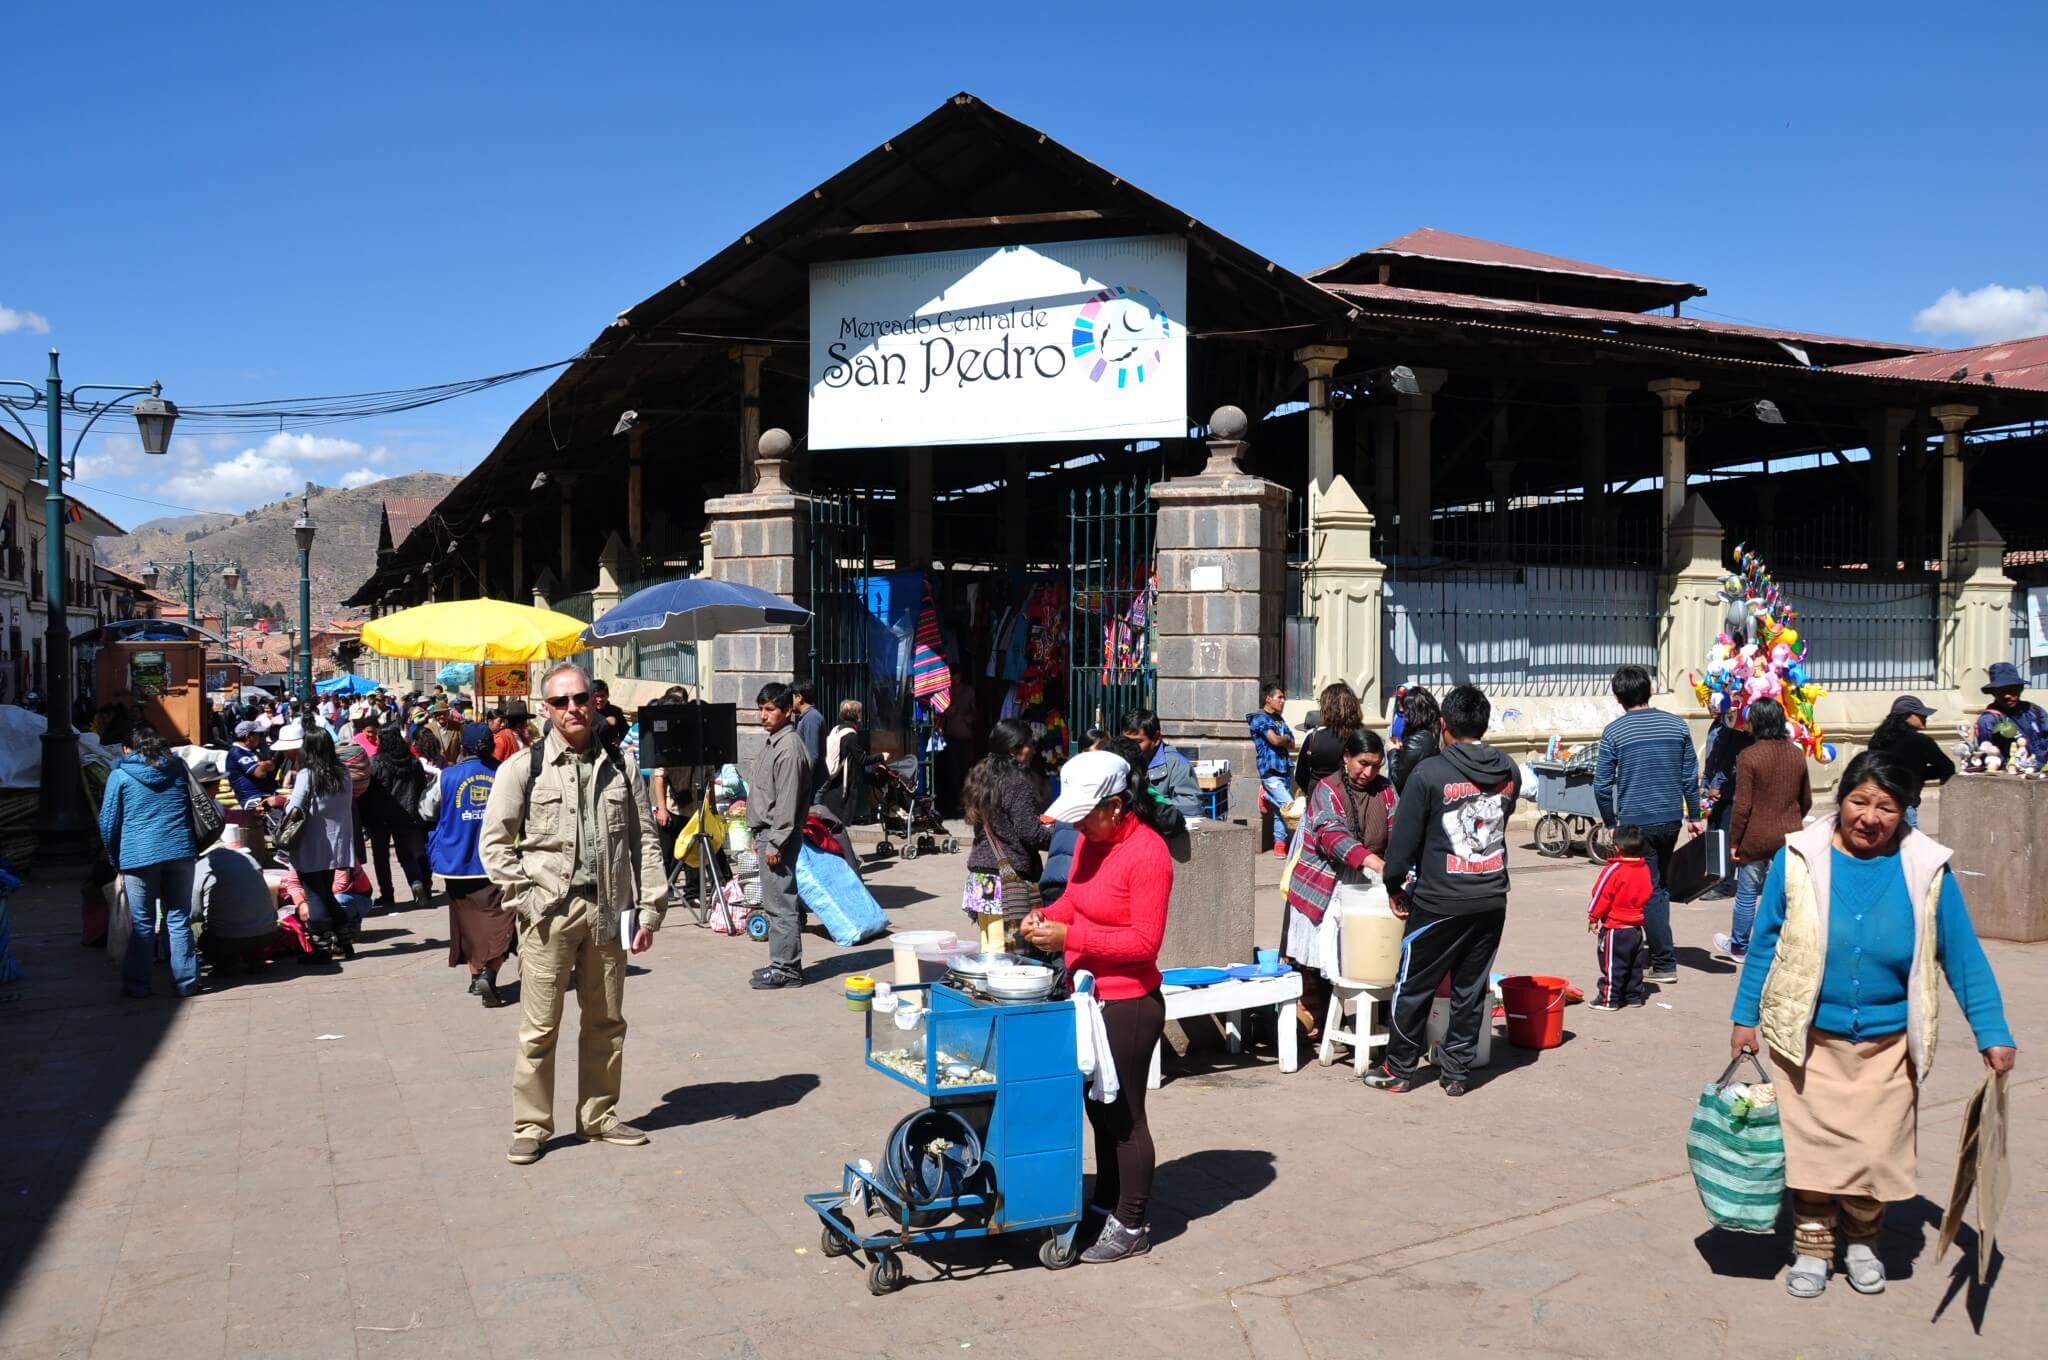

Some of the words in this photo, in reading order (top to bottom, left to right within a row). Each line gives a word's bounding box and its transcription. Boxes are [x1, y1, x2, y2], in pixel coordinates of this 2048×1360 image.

[839, 312, 932, 341] Mercado
[938, 306, 1016, 335] Central
[1020, 304, 1049, 331] de
[823, 342, 907, 388] San
[919, 332, 1066, 393] Pedro
[1446, 852, 1505, 874] RAIDERS
